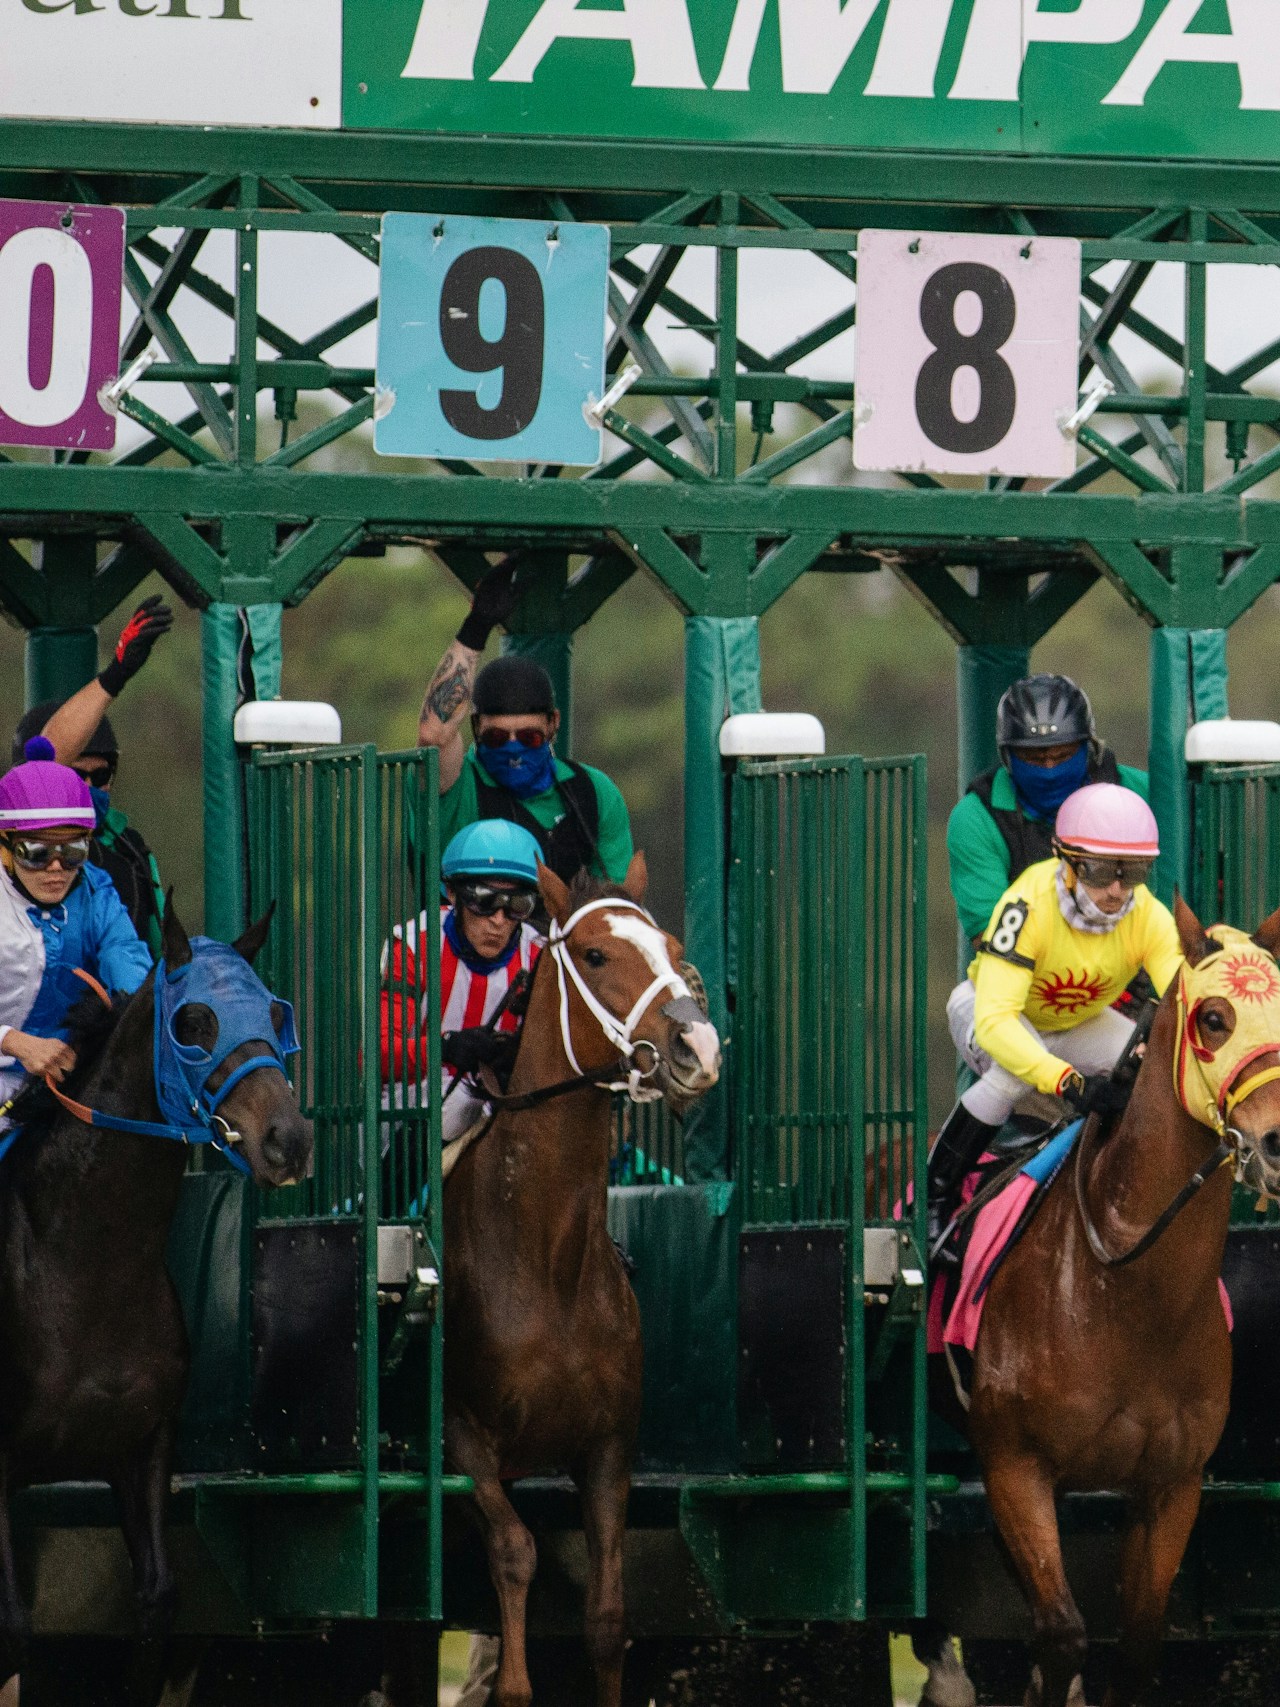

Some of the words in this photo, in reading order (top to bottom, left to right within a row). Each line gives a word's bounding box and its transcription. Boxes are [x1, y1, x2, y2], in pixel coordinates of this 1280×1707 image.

[0, 227, 94, 427] 0
[440, 246, 545, 441] 9
[915, 262, 1016, 454] 8
[992, 907, 1024, 953] 8
